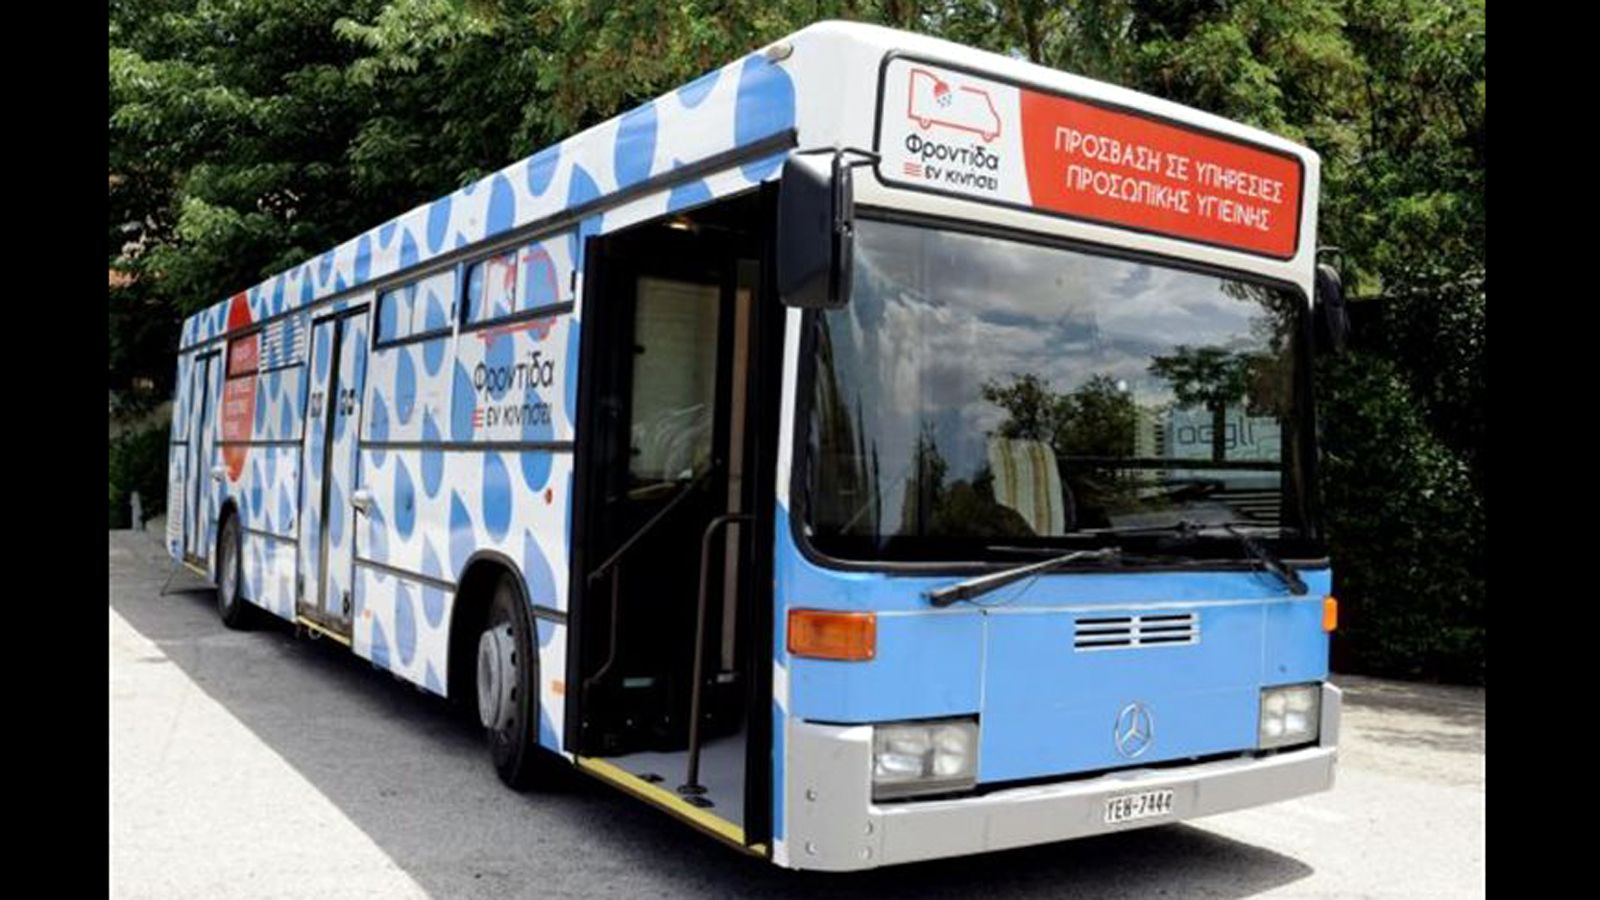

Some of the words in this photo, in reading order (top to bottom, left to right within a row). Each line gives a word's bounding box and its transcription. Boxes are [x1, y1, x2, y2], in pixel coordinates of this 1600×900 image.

[905, 133, 998, 170] Φροντίδα
[1054, 126, 1161, 174] ΠΡΟΣΒΑΣΗ
[1165, 153, 1190, 181] ΣΕ
[1195, 161, 1284, 204] ΥΠΗΡΕΣΙΕΣ
[1066, 164, 1191, 214] ΠΡΟΣΩΠΙΚΗΣ
[1196, 192, 1270, 231] ΥΓΙΕΙΝΗΣ
[474, 351, 555, 402] Φροντίδα
